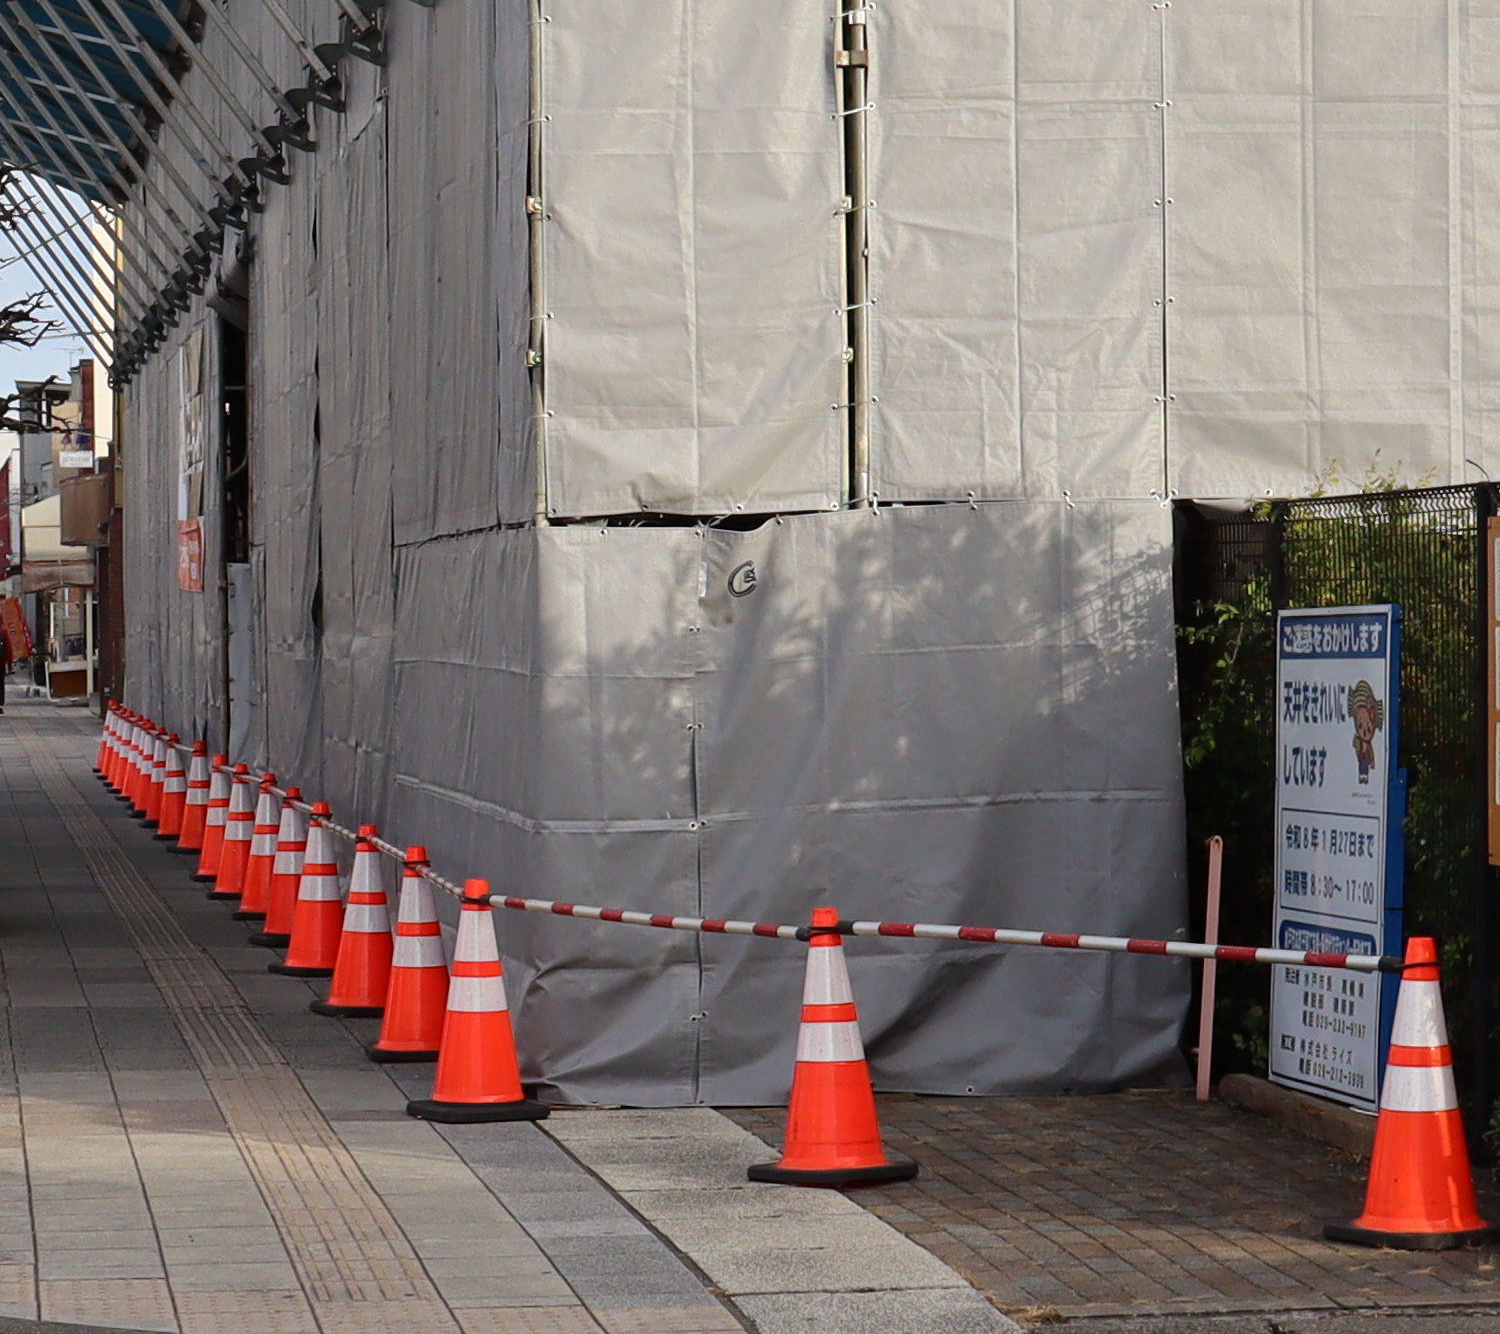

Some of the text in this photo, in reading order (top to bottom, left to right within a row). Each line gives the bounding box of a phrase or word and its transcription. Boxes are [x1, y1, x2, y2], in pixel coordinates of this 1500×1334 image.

[1283, 621, 1384, 654] ご迷惑をおかけします
[1283, 680, 1347, 725] 天井をきれいに
[1283, 744, 1327, 788] しています
